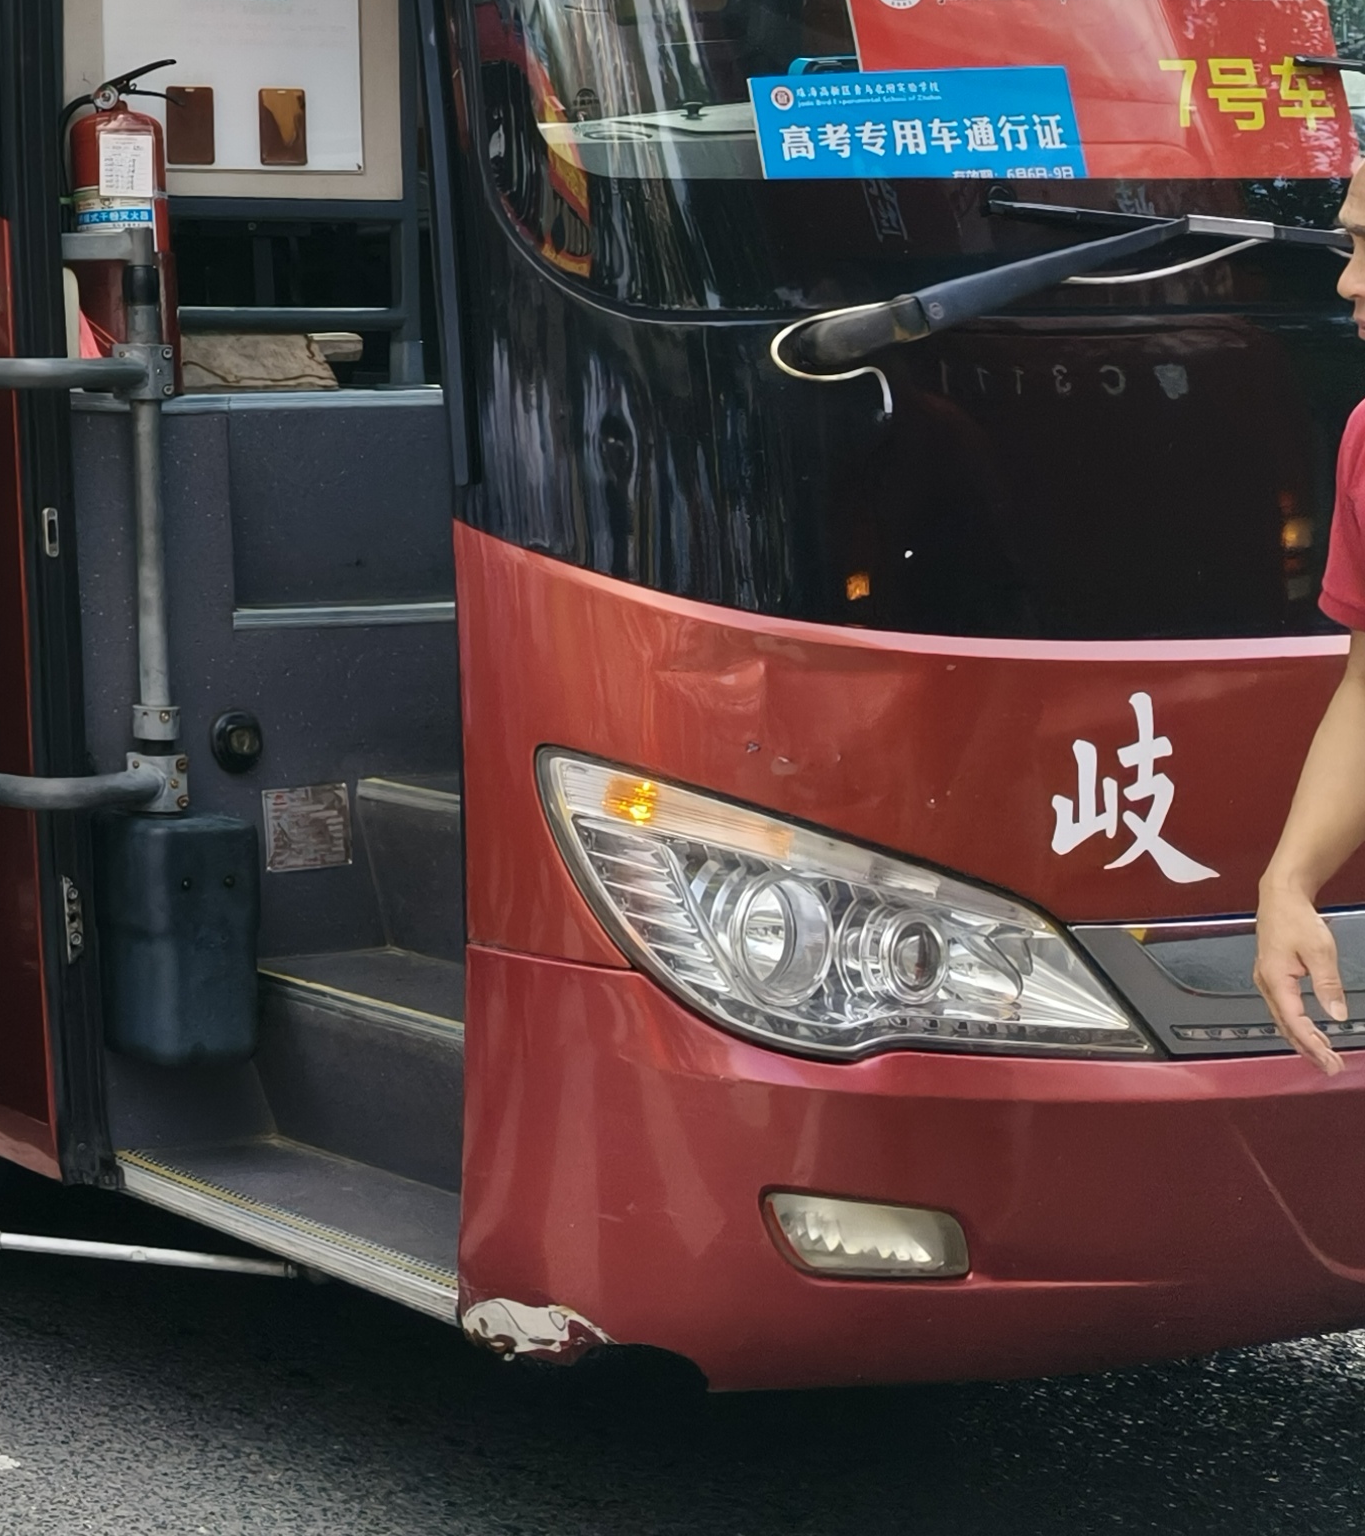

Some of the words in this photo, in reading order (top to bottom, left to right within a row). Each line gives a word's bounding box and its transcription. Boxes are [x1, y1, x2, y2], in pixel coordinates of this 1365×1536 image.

[1157, 56, 1336, 131] 7号车
[778, 113, 1068, 162] 高考专用车通行证
[1050, 690, 1221, 883] 岐
